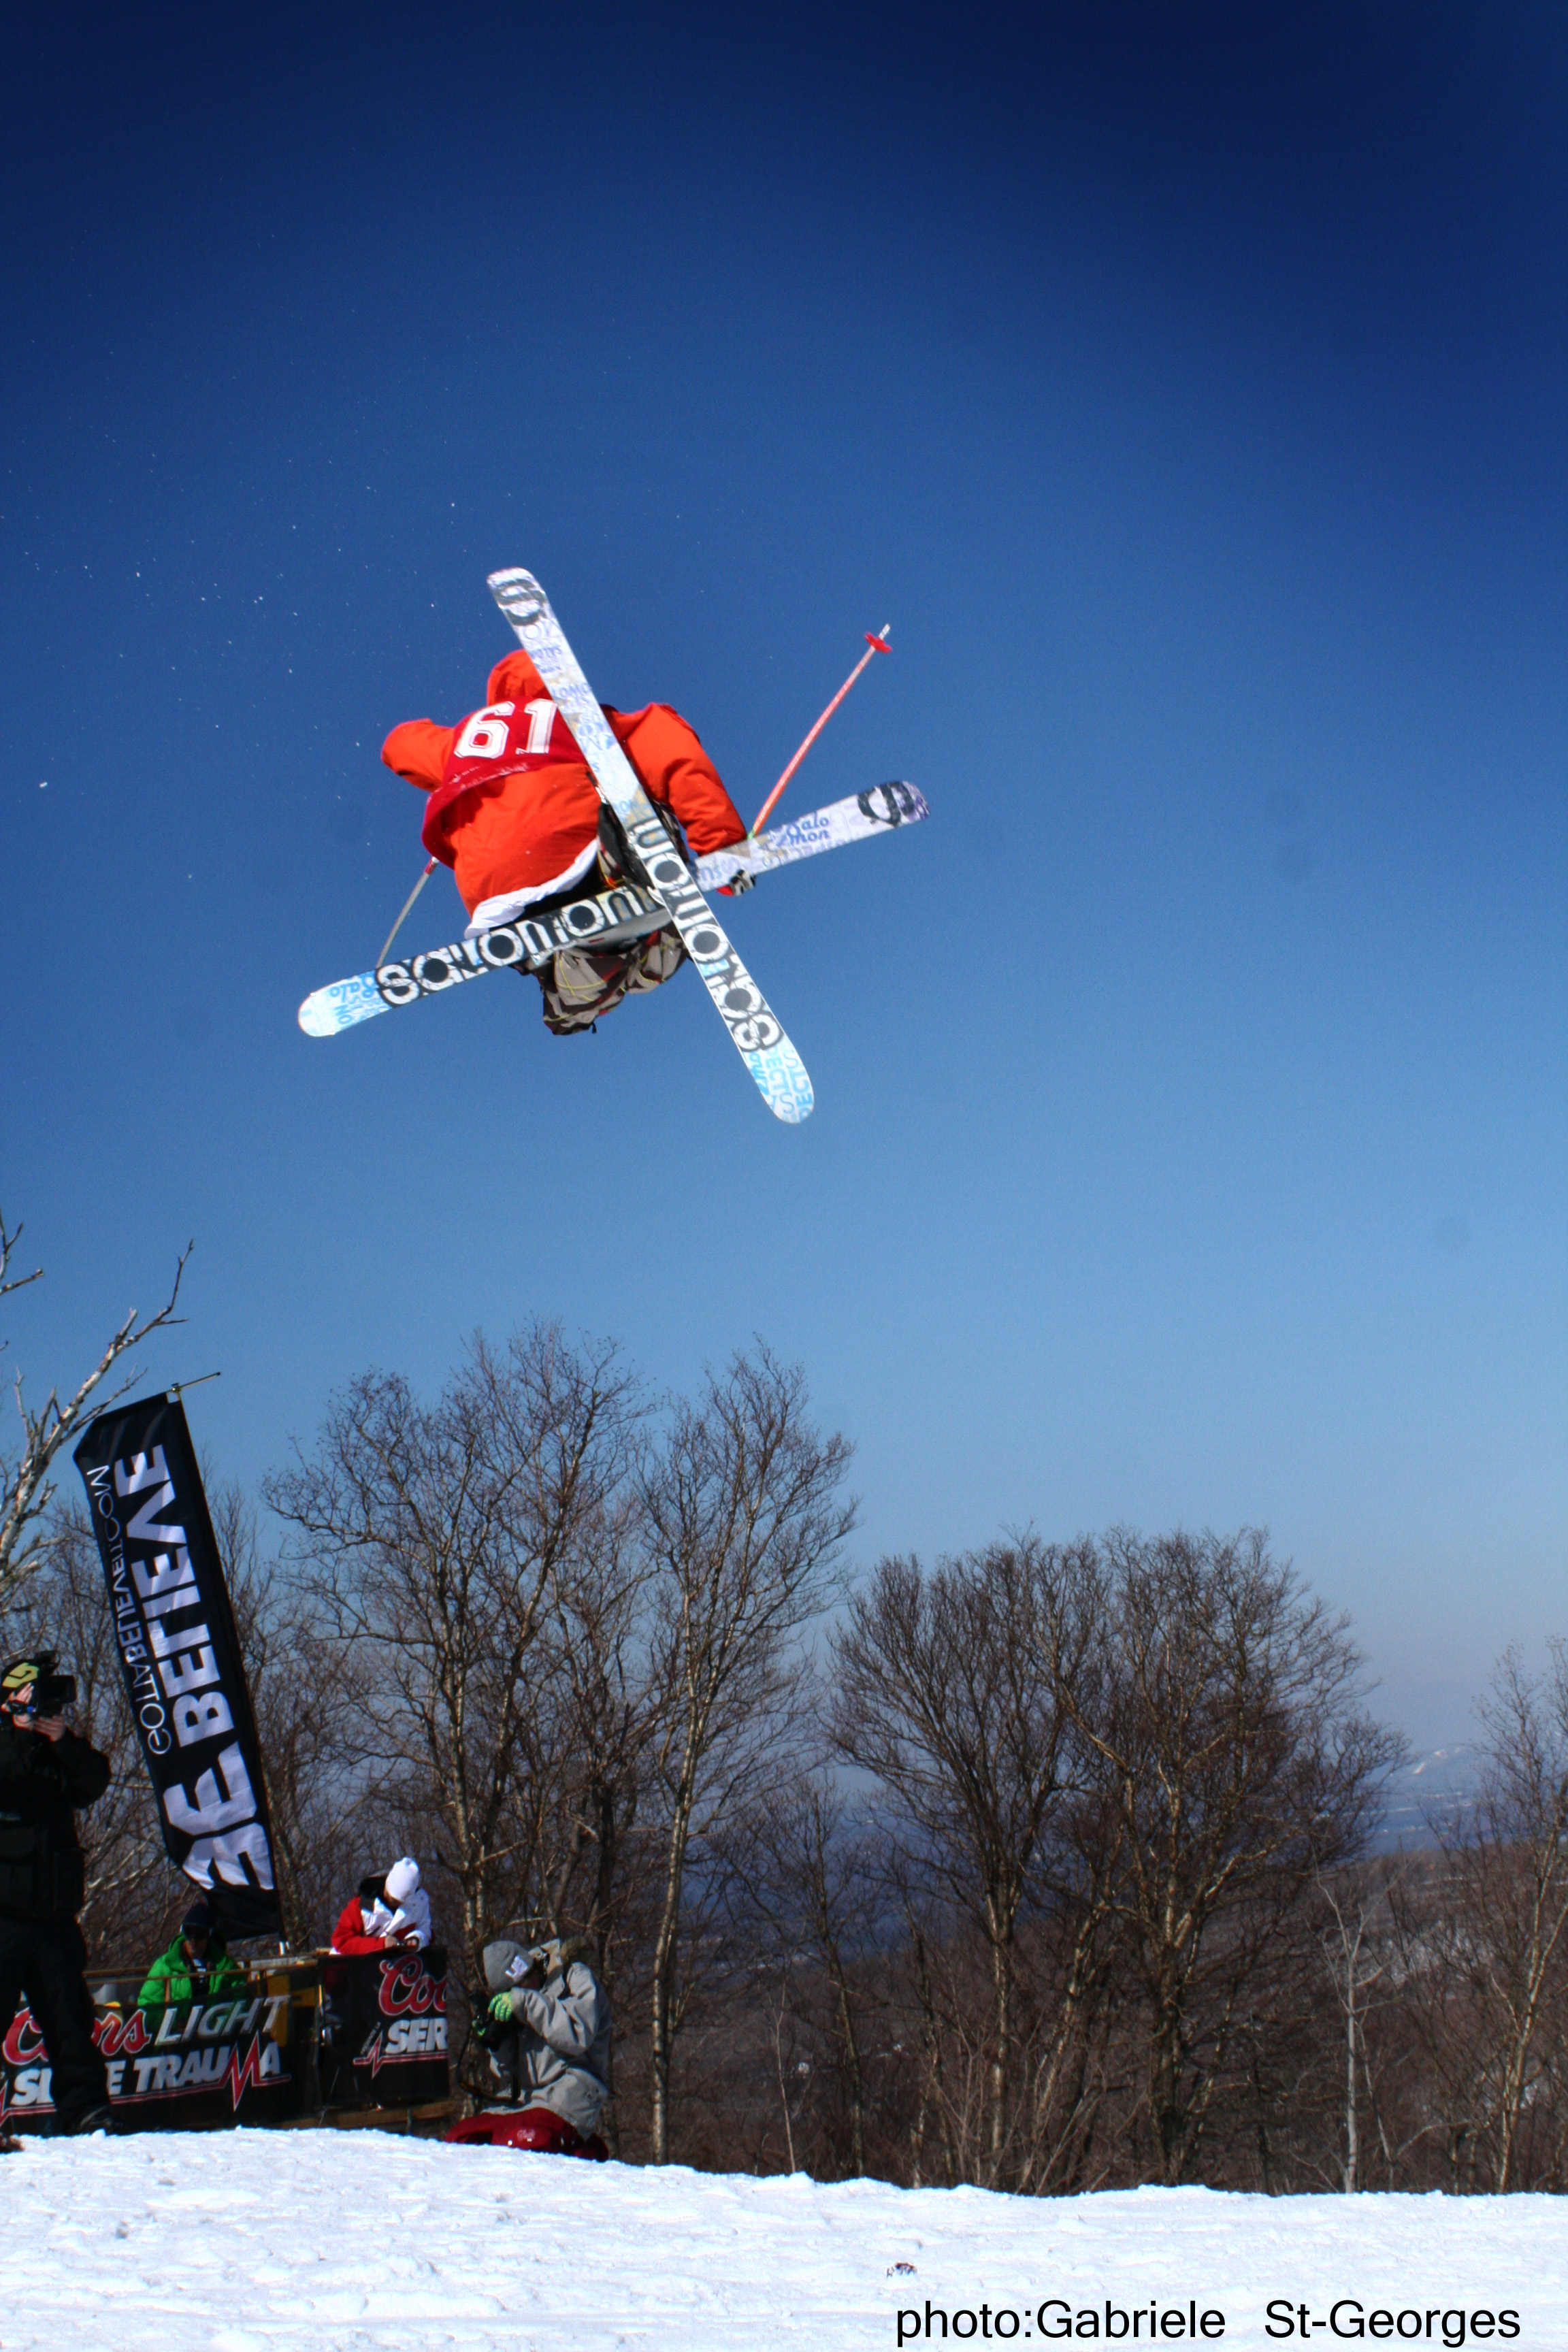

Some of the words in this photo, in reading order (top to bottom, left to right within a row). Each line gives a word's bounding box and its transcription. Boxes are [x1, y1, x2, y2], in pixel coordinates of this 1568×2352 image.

[454, 698, 557, 759] 61
[376, 886, 644, 1007] salomon
[630, 817, 783, 1053] salomon
[154, 1995, 292, 2046] LIGHT
[133, 2029, 281, 2095] TRAUMA
